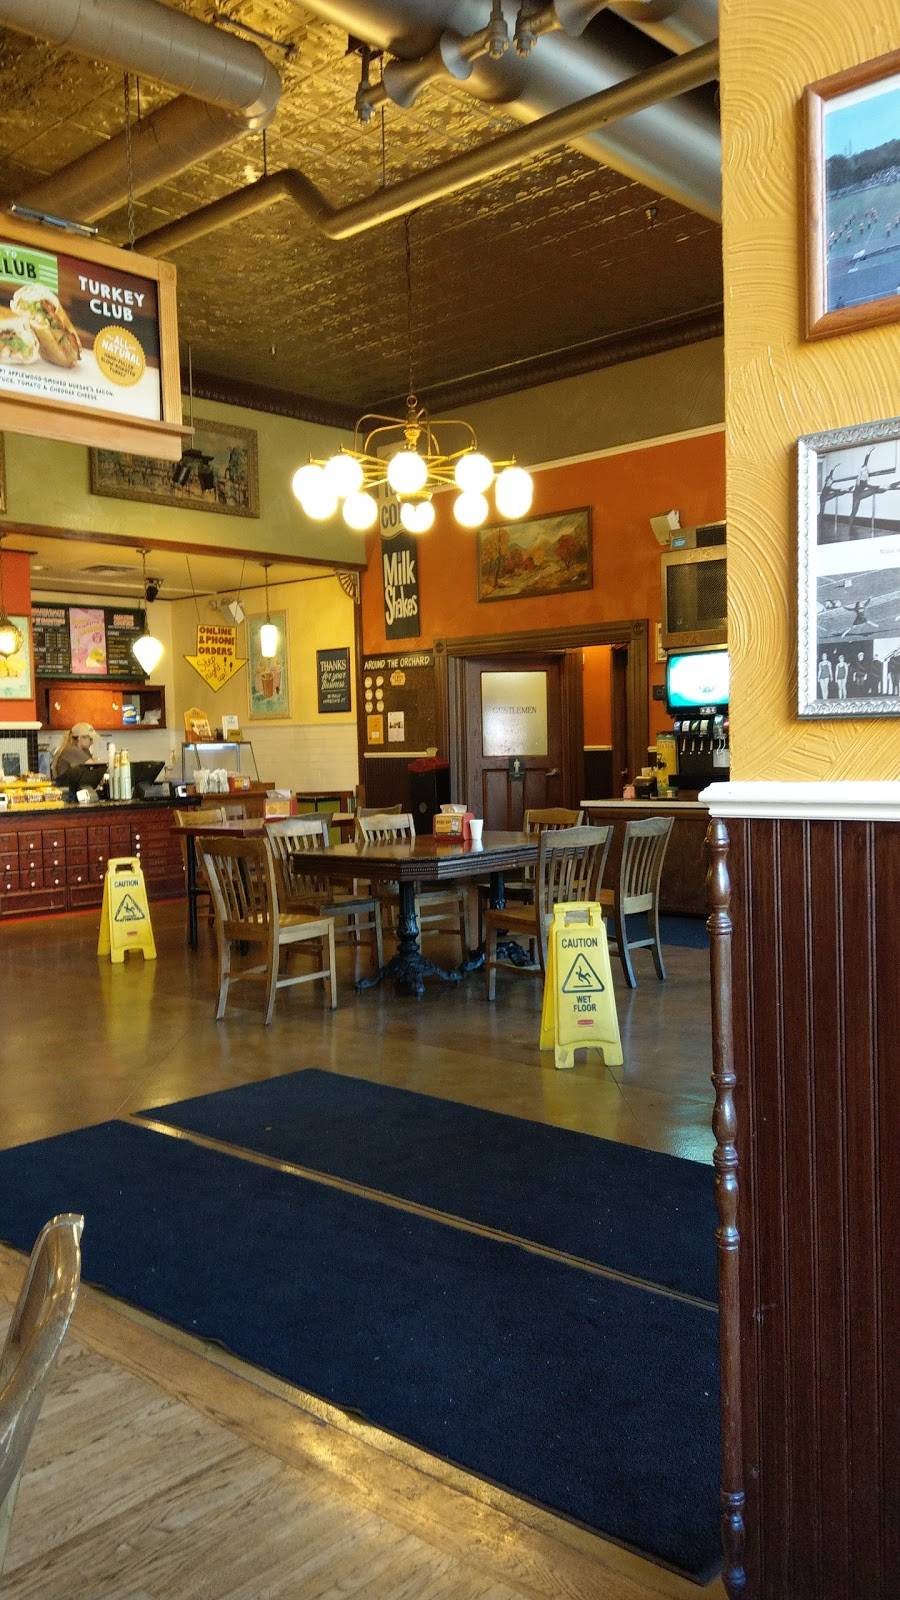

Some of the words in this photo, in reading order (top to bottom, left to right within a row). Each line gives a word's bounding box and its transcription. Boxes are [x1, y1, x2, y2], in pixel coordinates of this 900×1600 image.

[0, 257, 37, 279] LUB
[78, 275, 145, 307] TURKEY
[89, 298, 133, 322] CLUB
[383, 550, 416, 588] Milk
[385, 585, 418, 626] Shakes
[199, 626, 233, 636] ONLINE
[198, 646, 233, 656] ORDERS
[320, 659, 347, 672] THANKS
[363, 659, 386, 671] AROUND
[388, 658, 399, 669] THE
[400, 655, 430, 668] ORCHARD
[114, 880, 139, 888] CAUTION
[561, 938, 598, 949] CAUTION
[576, 996, 592, 1004] WET
[573, 1003, 597, 1012] FLOOR
